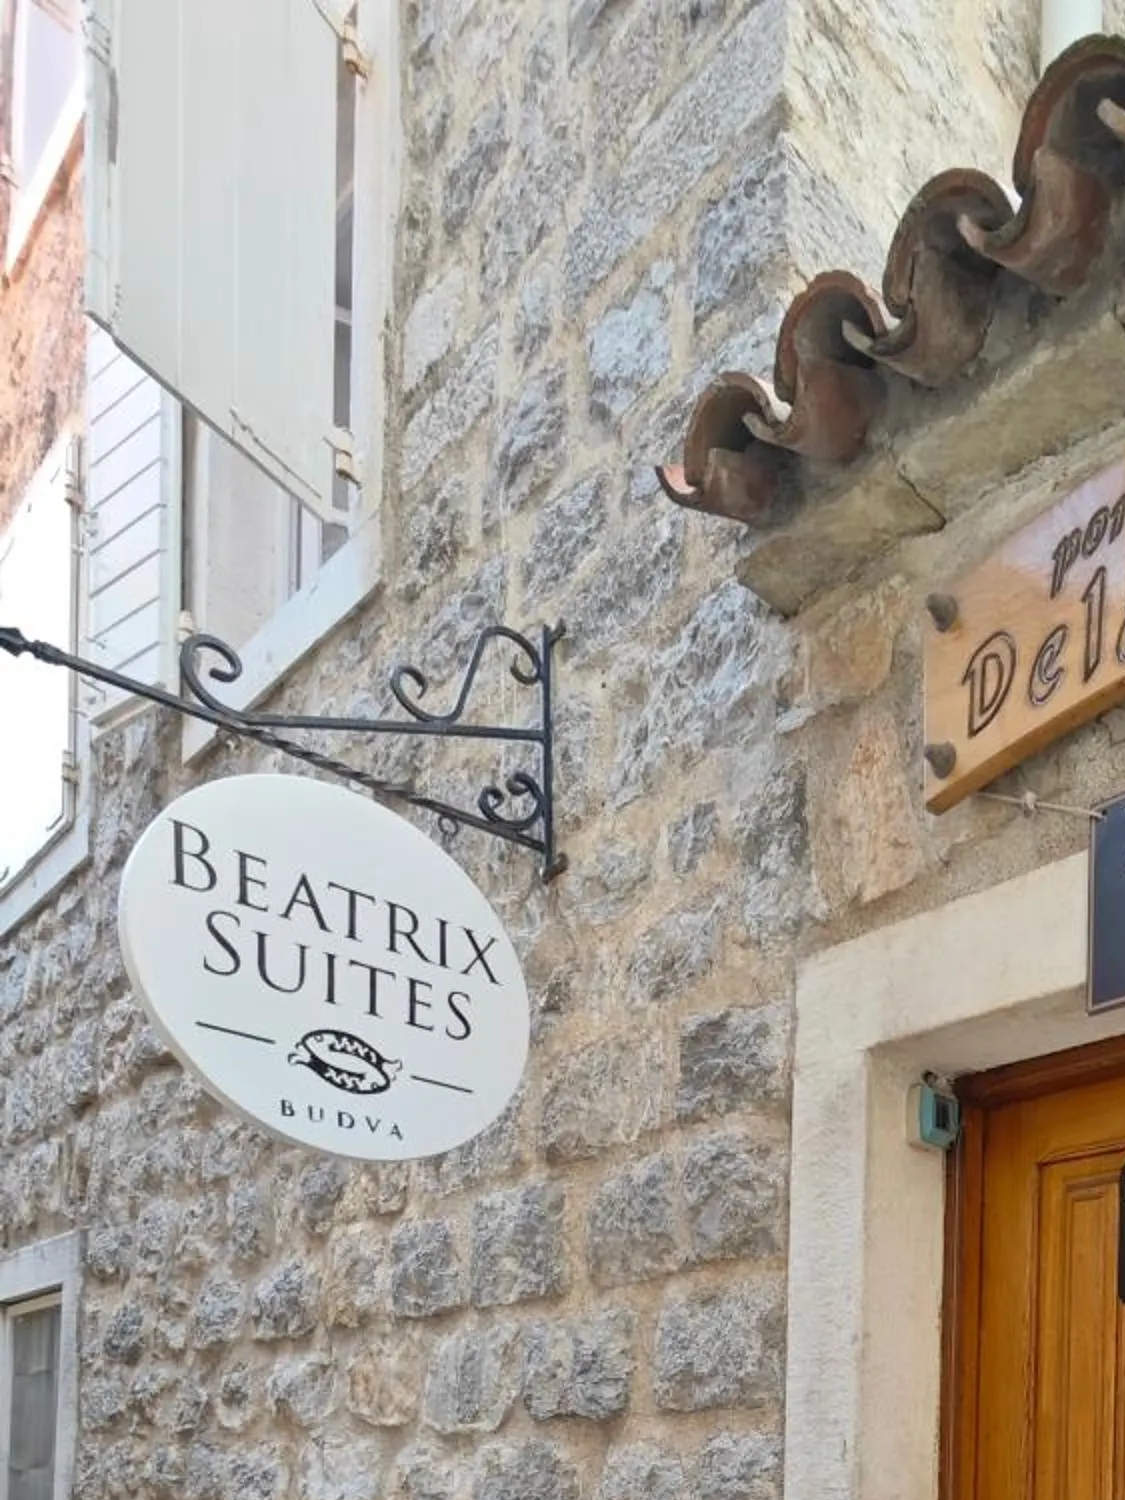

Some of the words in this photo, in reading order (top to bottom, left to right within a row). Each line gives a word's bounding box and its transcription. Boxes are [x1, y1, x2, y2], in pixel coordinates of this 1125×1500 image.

[168, 818, 502, 986] BEATRIX
[203, 910, 471, 1041] SUITES
[280, 1099, 404, 1140] BUDVA
